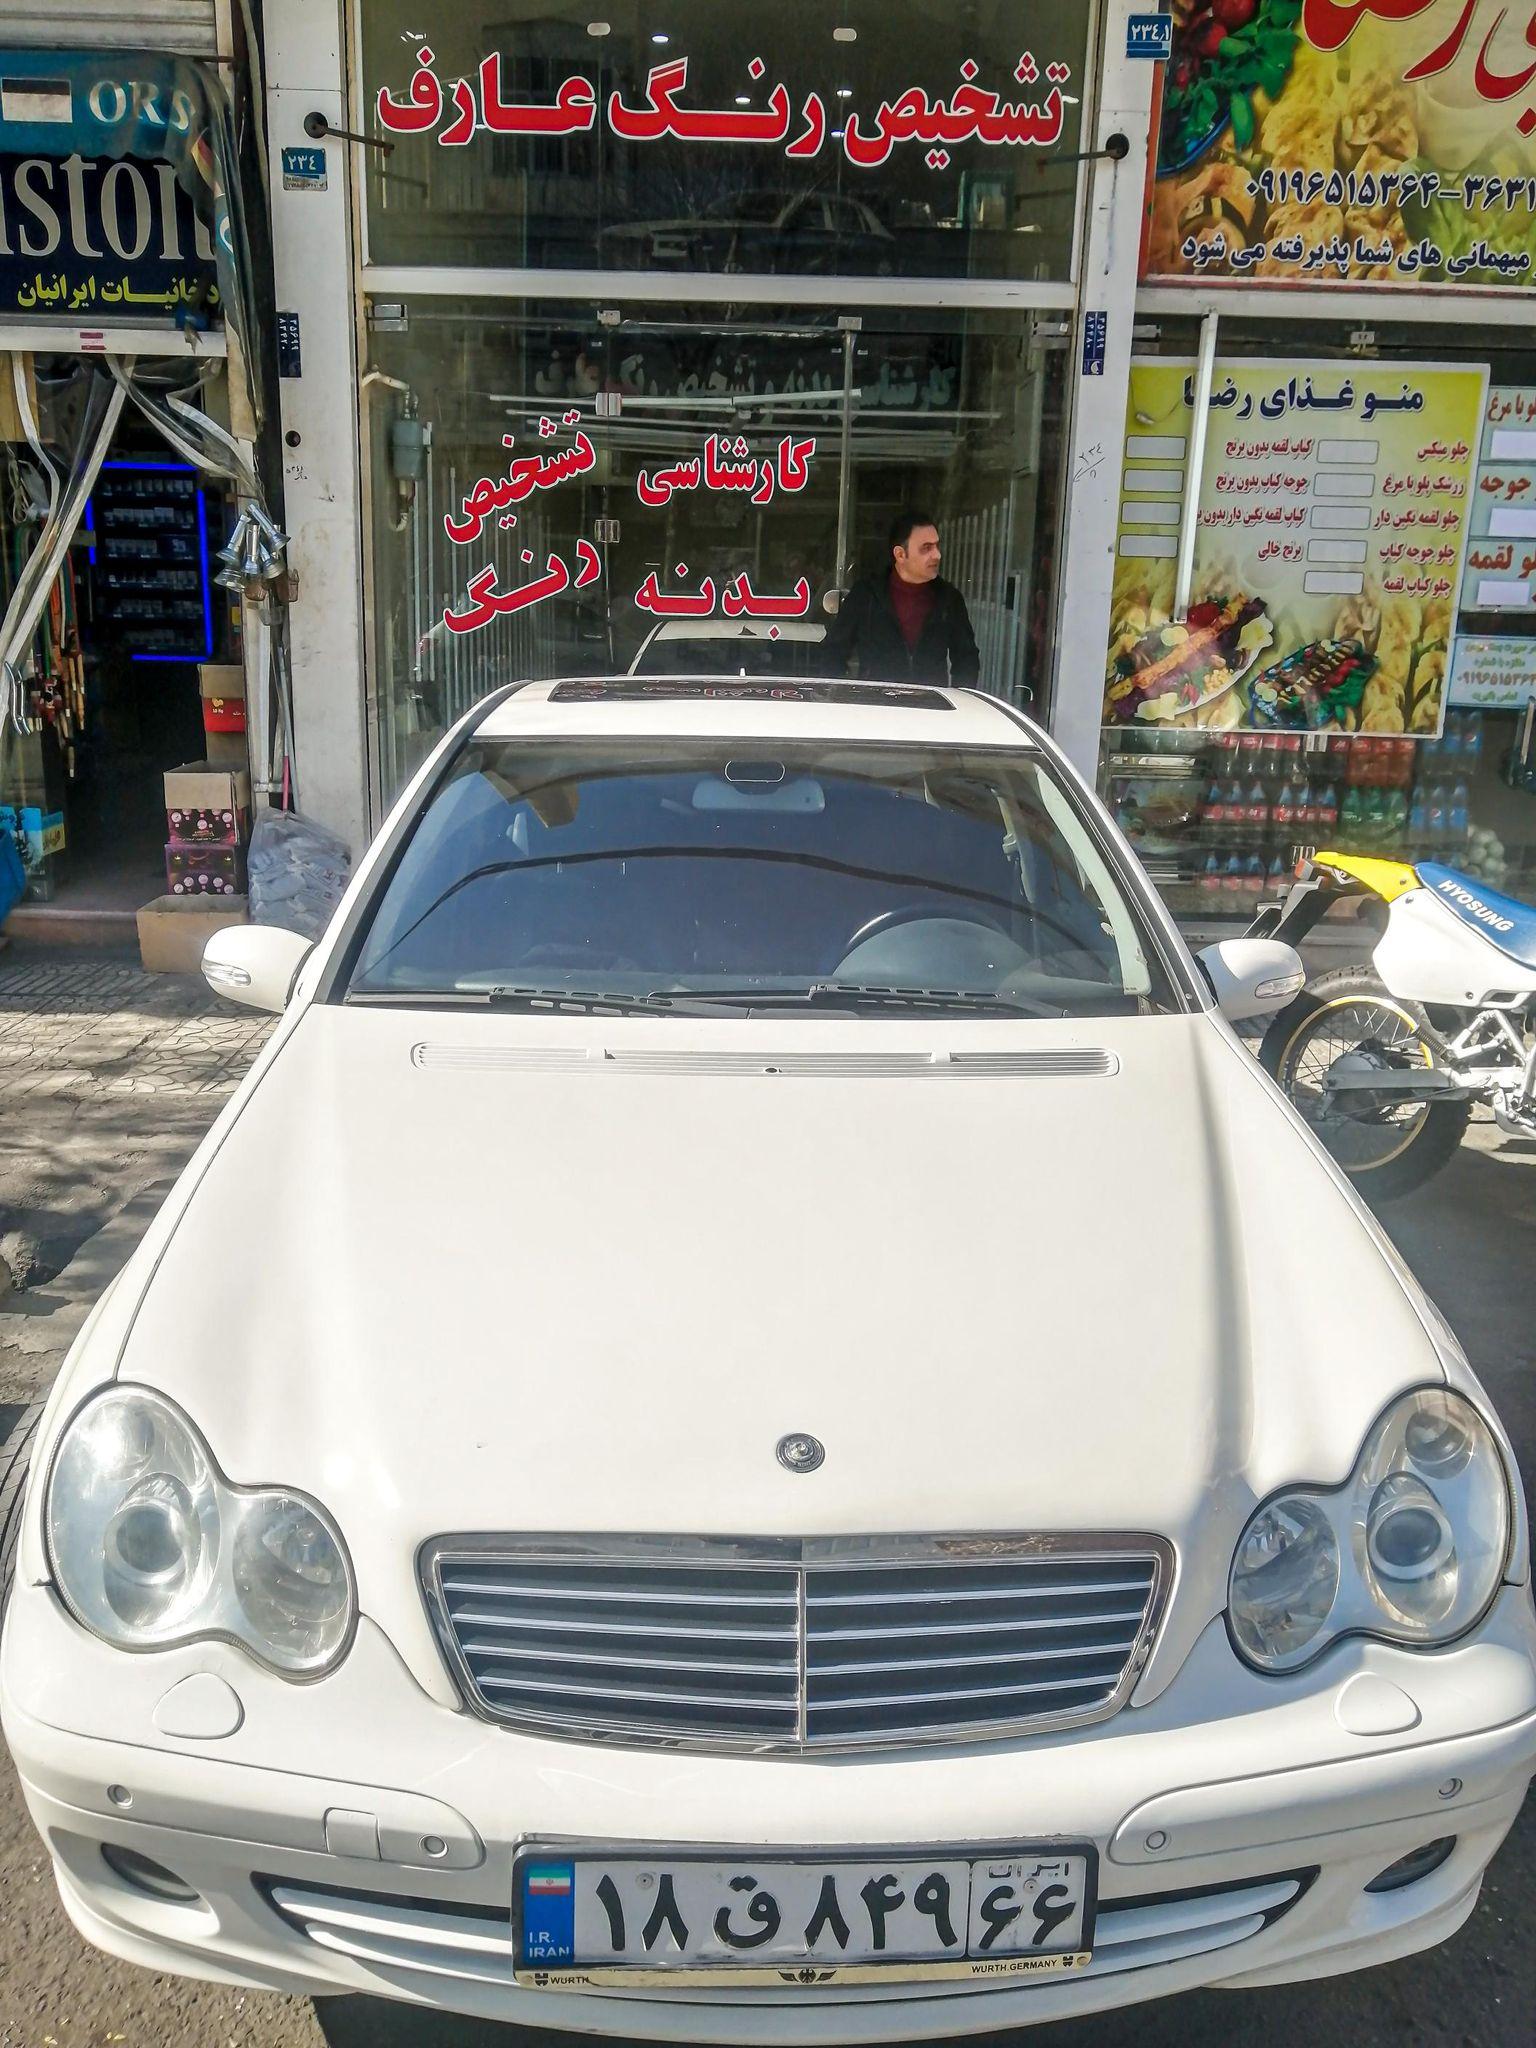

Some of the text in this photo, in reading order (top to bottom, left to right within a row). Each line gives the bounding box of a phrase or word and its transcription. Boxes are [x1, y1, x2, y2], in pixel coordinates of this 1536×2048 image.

[376, 45, 1070, 168] تشخیص رنگ عارف
[1182, 233, 1531, 275] میهمانی های شما پذیرفته می شود
[17, 273, 96, 308] ایرانیان
[1182, 375, 1424, 421] منو غذای رضا
[444, 408, 596, 544] تشخیص
[637, 433, 816, 506] کارشناسی
[1480, 475, 1531, 500] جوجه
[1468, 544, 1514, 570] لقمه
[443, 538, 601, 634] رنگ
[634, 562, 810, 641] بدنه
[1438, 880, 1515, 931] HYOSUNG
[596, 1872, 1077, 1952] ۱۸ ق ۸۴۹ ۶۶
[529, 1931, 555, 1944] I.R.
[529, 1946, 570, 1958] IRAN
[550, 1976, 589, 1985] WURTH
[971, 1959, 1058, 1974] WURTH GERMANY
